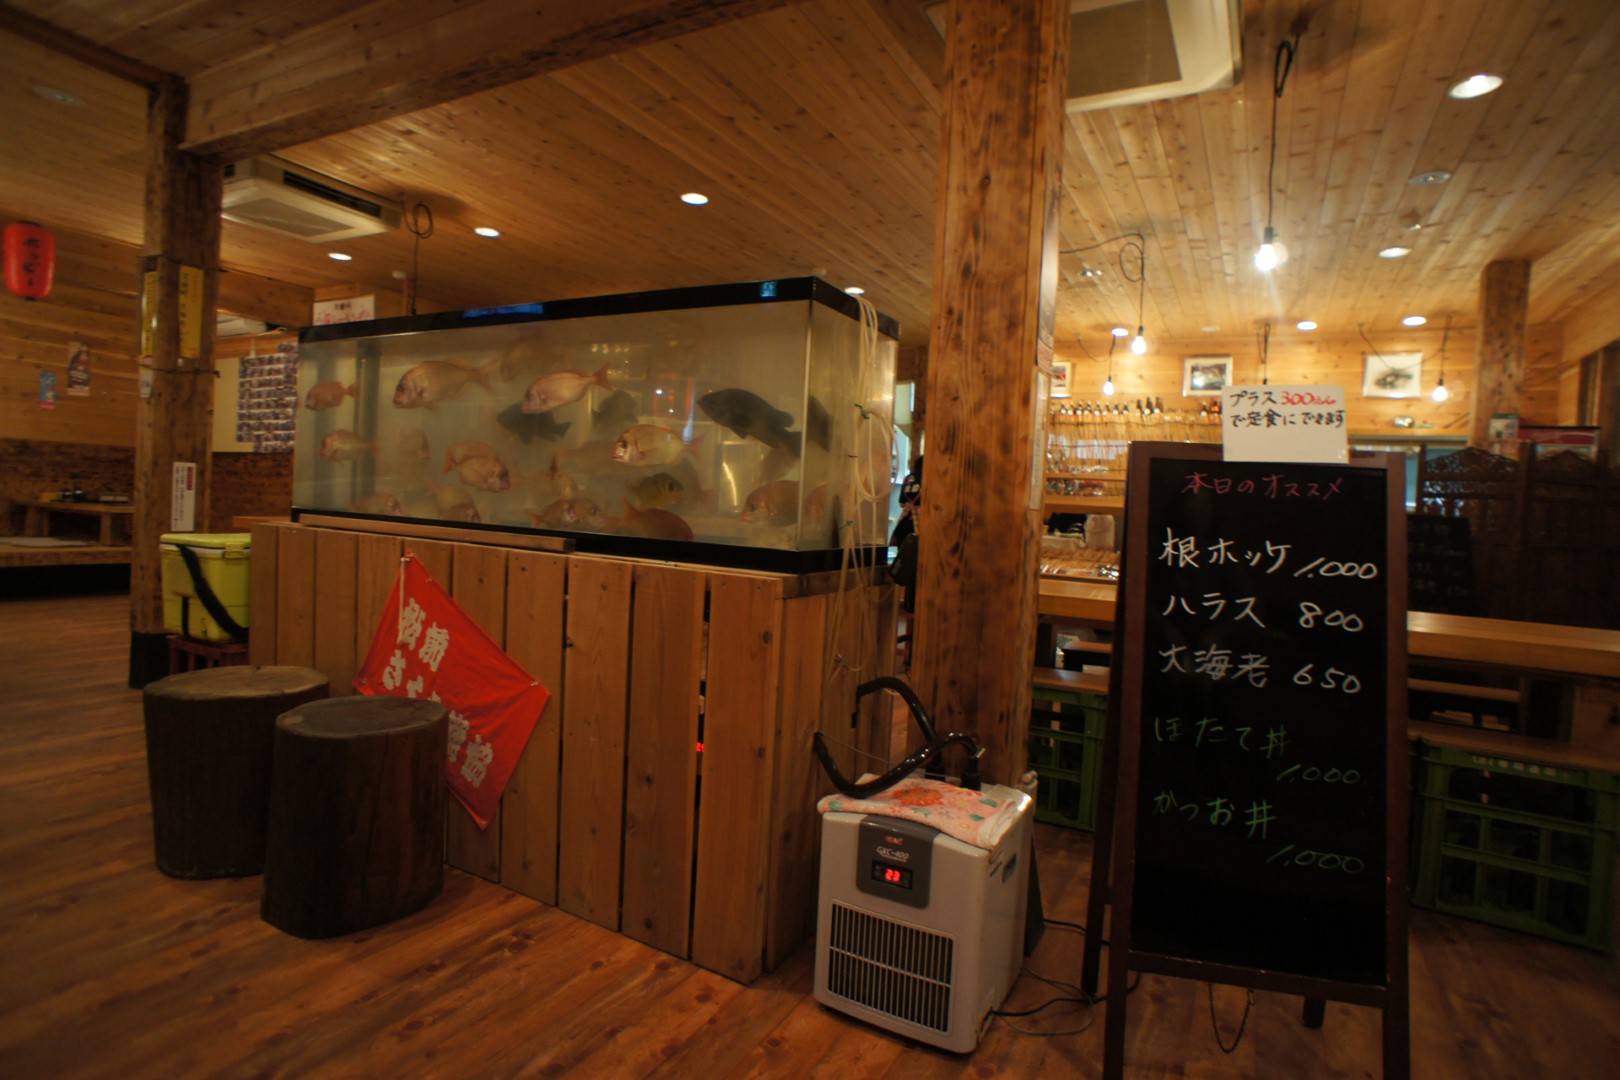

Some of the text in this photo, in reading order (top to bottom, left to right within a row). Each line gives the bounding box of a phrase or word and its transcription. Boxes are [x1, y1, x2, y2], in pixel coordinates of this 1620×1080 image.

[1181, 471, 1343, 500] 本日のオススメ
[1158, 527, 1292, 573] 根ホッケ
[1162, 592, 1364, 632] ハラス 800
[1158, 643, 1362, 694] 大海老 650
